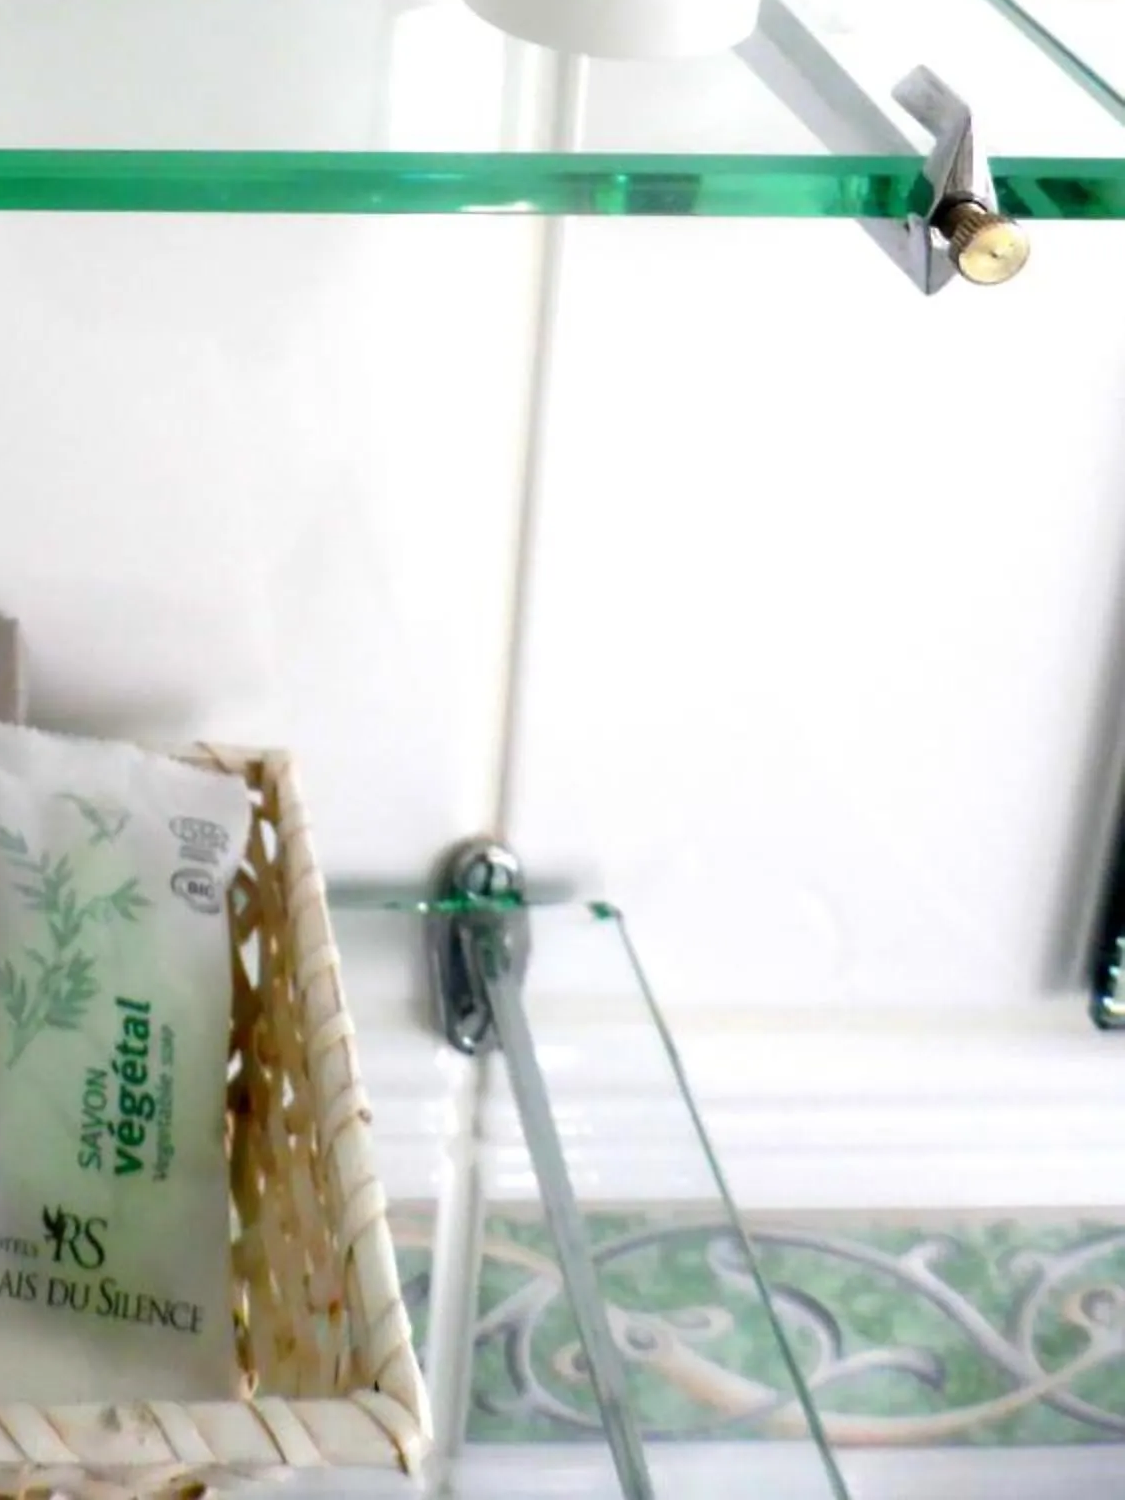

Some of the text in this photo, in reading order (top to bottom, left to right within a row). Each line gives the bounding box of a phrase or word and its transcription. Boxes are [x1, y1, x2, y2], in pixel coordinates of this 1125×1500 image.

[78, 1067, 108, 1171] SAVON
[107, 996, 156, 1176] végétal
[46, 1276, 90, 1311] DU
[95, 1276, 205, 1334] SILENCE
